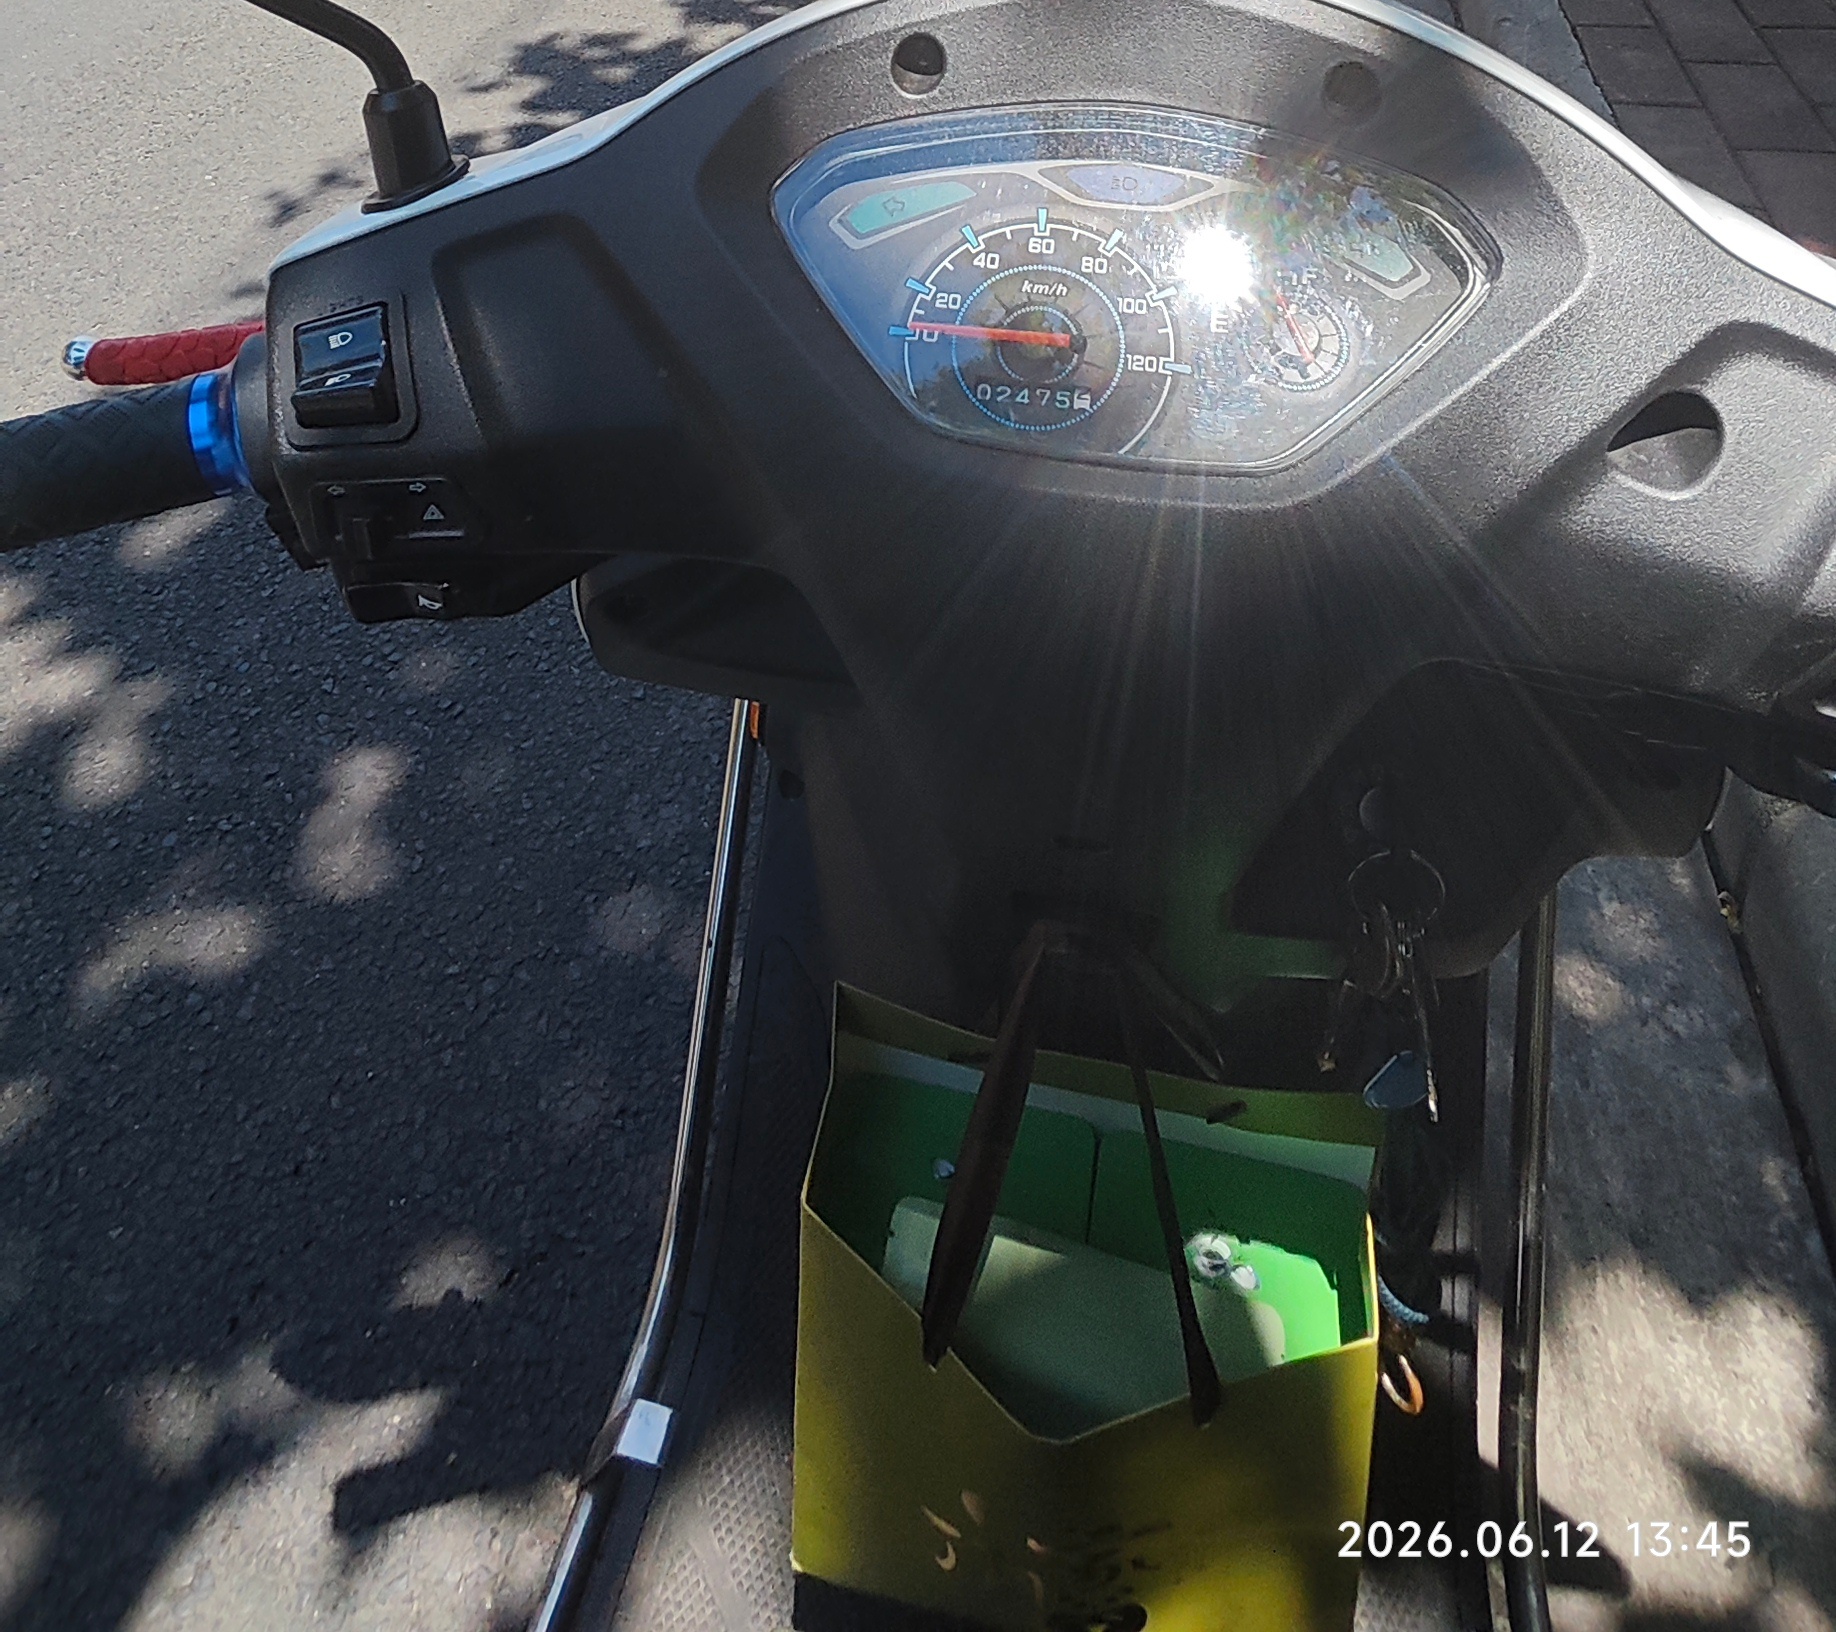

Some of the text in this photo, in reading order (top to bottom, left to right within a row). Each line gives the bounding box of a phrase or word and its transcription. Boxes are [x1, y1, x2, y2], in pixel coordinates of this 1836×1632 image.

[1027, 238, 1055, 254] 60
[972, 252, 1000, 269] 40
[1080, 256, 1108, 274] 80
[1021, 279, 1069, 298] km/h
[934, 292, 961, 310] 20
[1117, 296, 1147, 315] 100
[1210, 313, 1229, 334] E
[1125, 354, 1158, 372] 120
